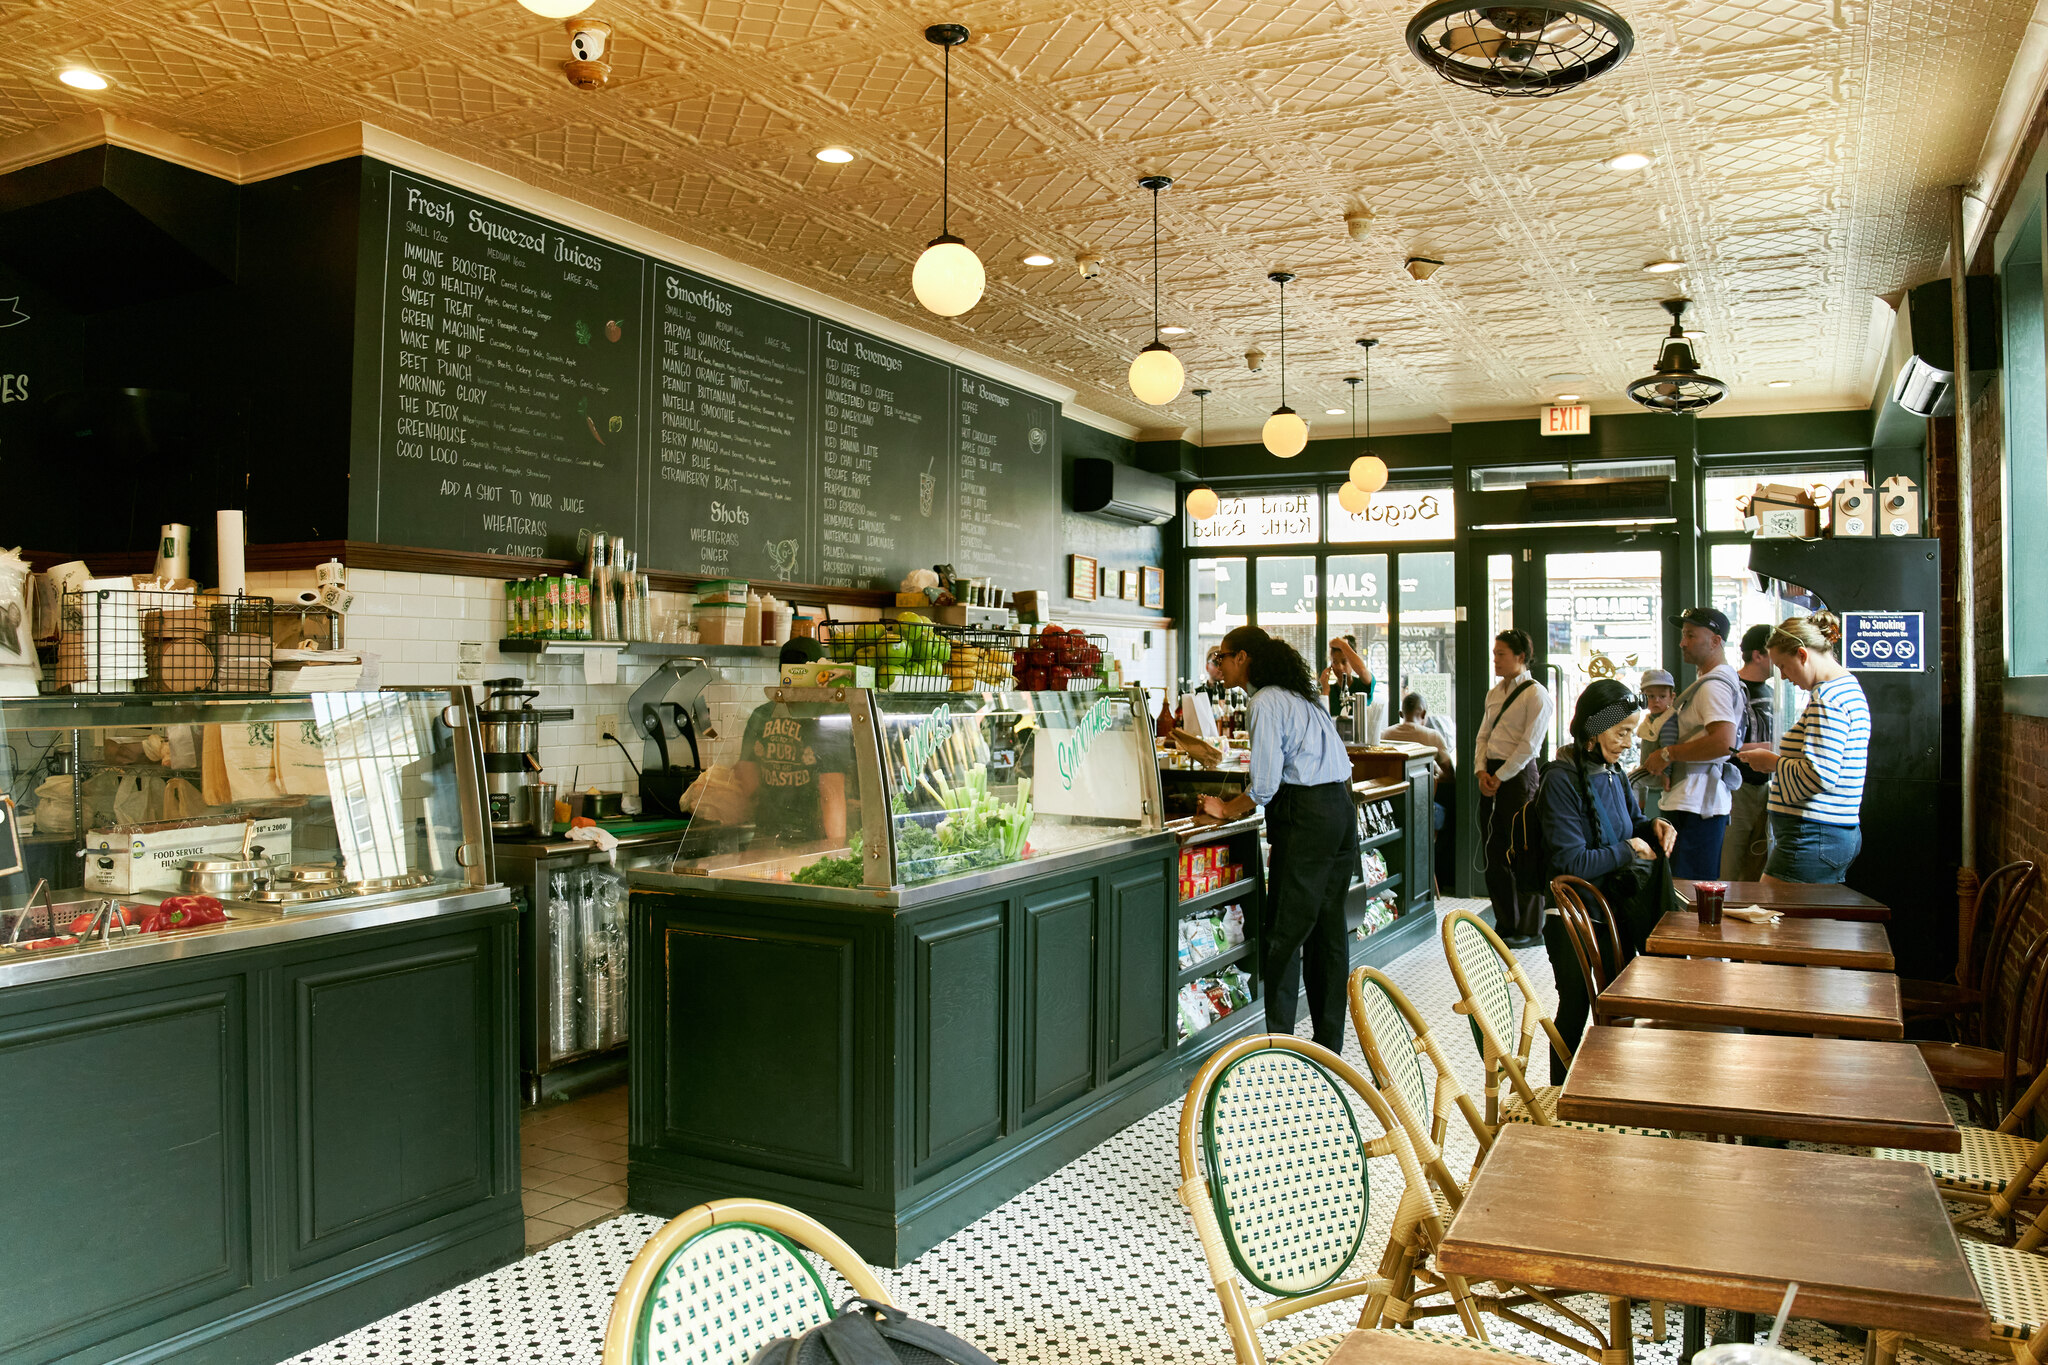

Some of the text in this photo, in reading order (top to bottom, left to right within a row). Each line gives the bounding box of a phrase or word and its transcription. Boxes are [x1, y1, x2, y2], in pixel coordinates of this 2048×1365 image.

[406, 187, 601, 271] Fresh Squeezed Juices
[404, 242, 443, 268] IMMUNE
[452, 256, 496, 283] BOOSTER
[406, 221, 429, 238] SMALL
[433, 229, 449, 243] 12oz
[487, 248, 510, 263] MEDIUM
[563, 271, 581, 284] LARGE
[403, 264, 416, 282] OH
[423, 270, 434, 286] SO
[441, 275, 484, 300] HEALTHY
[402, 285, 435, 308] SWEET
[444, 297, 473, 318] TREAT
[666, 276, 733, 316] Smoothies
[402, 308, 485, 343] GREEN MACHINE
[664, 321, 731, 354] PAPAYA SUNRISE
[400, 329, 471, 359] WAKE ME UP
[664, 340, 703, 362] THE HULK
[826, 331, 902, 371] Iced Beverages
[400, 351, 472, 382] BEET PUNCH
[663, 357, 691, 377] MANGO
[696, 367, 725, 386] ORANGE
[730, 375, 750, 392] TWIST
[826, 357, 860, 378] ICED COFFEE
[0, 374, 29, 402] ES
[399, 374, 487, 405] MORNING GLORY
[663, 375, 692, 394] PEANUT
[698, 385, 736, 406] BUTTANANA
[826, 373, 894, 402] COLD BREW ICED COFFEE
[962, 378, 1009, 407] Hot Beverages
[399, 395, 458, 421] THE DETOX
[663, 393, 695, 413] NUTELLA
[701, 403, 735, 423] SMOOTHIE
[825, 404, 874, 426] ICED AMERICANO
[826, 388, 865, 408] UNSWEETENED
[868, 400, 880, 413] ICED
[884, 405, 893, 417] TEA
[398, 418, 466, 444] GREENHOUSE
[825, 420, 858, 438] ICED LATTE
[962, 414, 970, 425] TEA
[1550, 406, 1583, 432] EXIT
[397, 440, 457, 465] COCO LOCO
[661, 430, 687, 447] BERRY
[692, 437, 718, 454] MANGO
[825, 436, 837, 448] ICED
[864, 444, 878, 458] LATTE
[661, 448, 686, 464] HONEY
[692, 454, 710, 470] BLUE
[825, 451, 872, 471] ICED CHAI LATTE
[662, 466, 710, 488] STRAWBERRY
[715, 475, 737, 492] BLAST
[441, 479, 584, 513] ADD A SHOT TO YOUR JUICE
[824, 497, 837, 510] ICED
[840, 500, 865, 516] ESPRESSO
[483, 514, 547, 537] WHEATGRASS
[711, 501, 749, 525] Shots
[824, 513, 854, 529] HOMEMADE
[858, 520, 886, 534] LEMONADE
[691, 528, 739, 546] WHEATGRASS
[824, 529, 895, 550] WATERMELON LEMONADE
[507, 544, 544, 559] GINGER
[701, 546, 728, 562] GINGER
[824, 544, 845, 559] PALMER
[1575, 597, 1649, 614] ORGANIC
[1860, 620, 1906, 630] No Smoking
[763, 719, 801, 741] BAGEL
[1057, 696, 1113, 790] SMOOTHIES
[901, 703, 952, 794] JUICES
[176, 847, 204, 856] SERVICE
